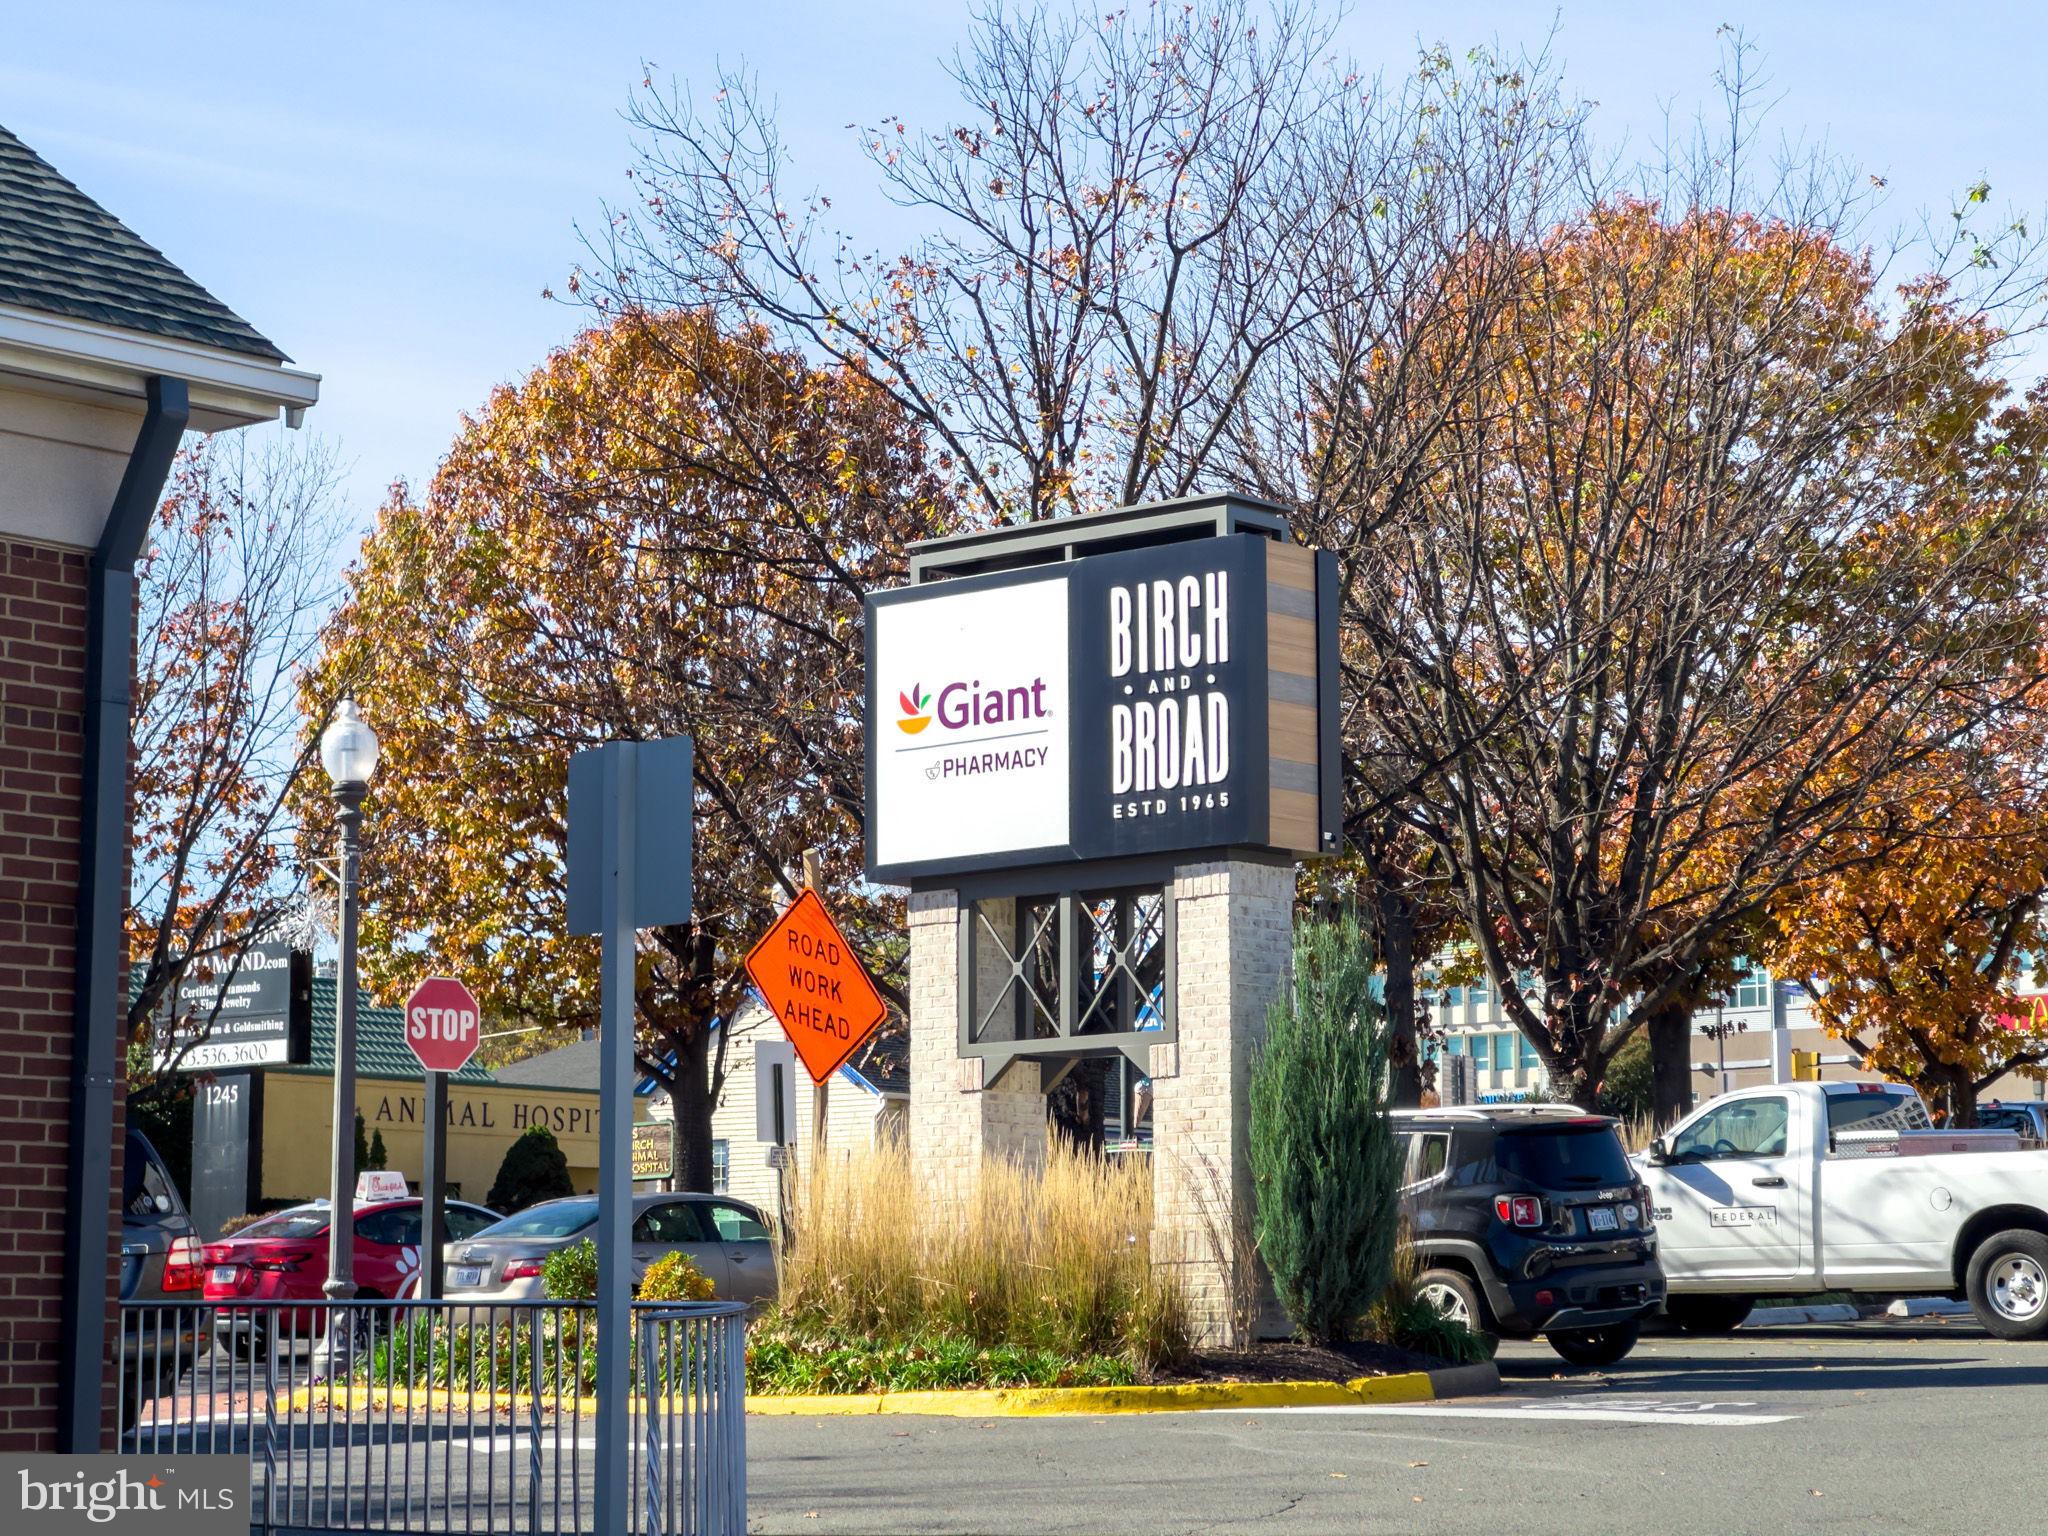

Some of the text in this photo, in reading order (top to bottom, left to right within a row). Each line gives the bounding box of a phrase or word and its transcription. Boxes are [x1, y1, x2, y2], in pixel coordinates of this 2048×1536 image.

[1110, 570, 1229, 677] BIRCH
[1148, 675, 1191, 694] AND
[938, 677, 1047, 730] Giant
[1112, 691, 1229, 795] BROAD
[943, 746, 1048, 778] PHARMACY
[1113, 792, 1230, 819] ESTD 1965
[788, 929, 840, 966] ROAD
[181, 981, 261, 999] Certified iamonds
[789, 964, 843, 1003] WORK
[221, 996, 251, 1009] Jewelry
[223, 1023, 231, 1033] &
[233, 1020, 284, 1033] Goldsmithing
[411, 1006, 475, 1042] STOP
[784, 999, 850, 1041] AHEAD
[174, 1042, 268, 1067] 03.536.3600
[206, 1085, 239, 1105] 1245
[632, 1161, 669, 1173] OSPITAL
[1598, 1191, 1613, 1200] Jeep
[1714, 1212, 1772, 1222] FEDERAL
